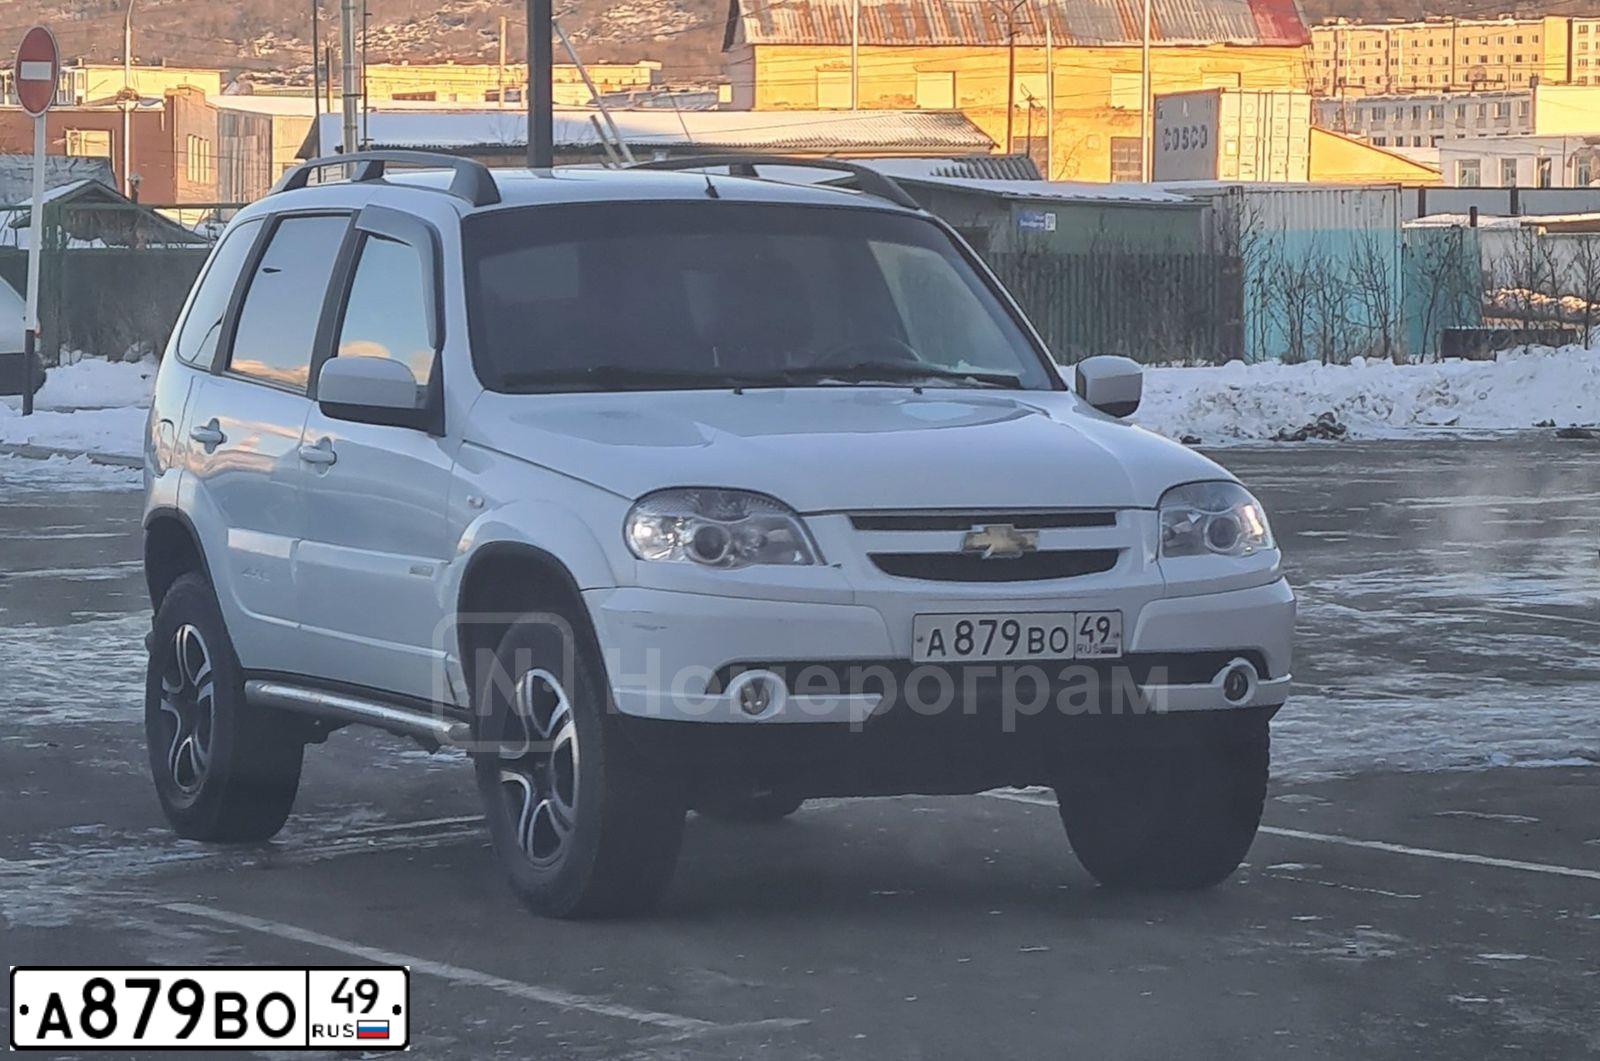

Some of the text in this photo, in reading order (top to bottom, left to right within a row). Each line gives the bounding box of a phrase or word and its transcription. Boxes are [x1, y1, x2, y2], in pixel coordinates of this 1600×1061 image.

[1164, 125, 1208, 151] COSCO
[926, 616, 1110, 657] А879ВО 49
